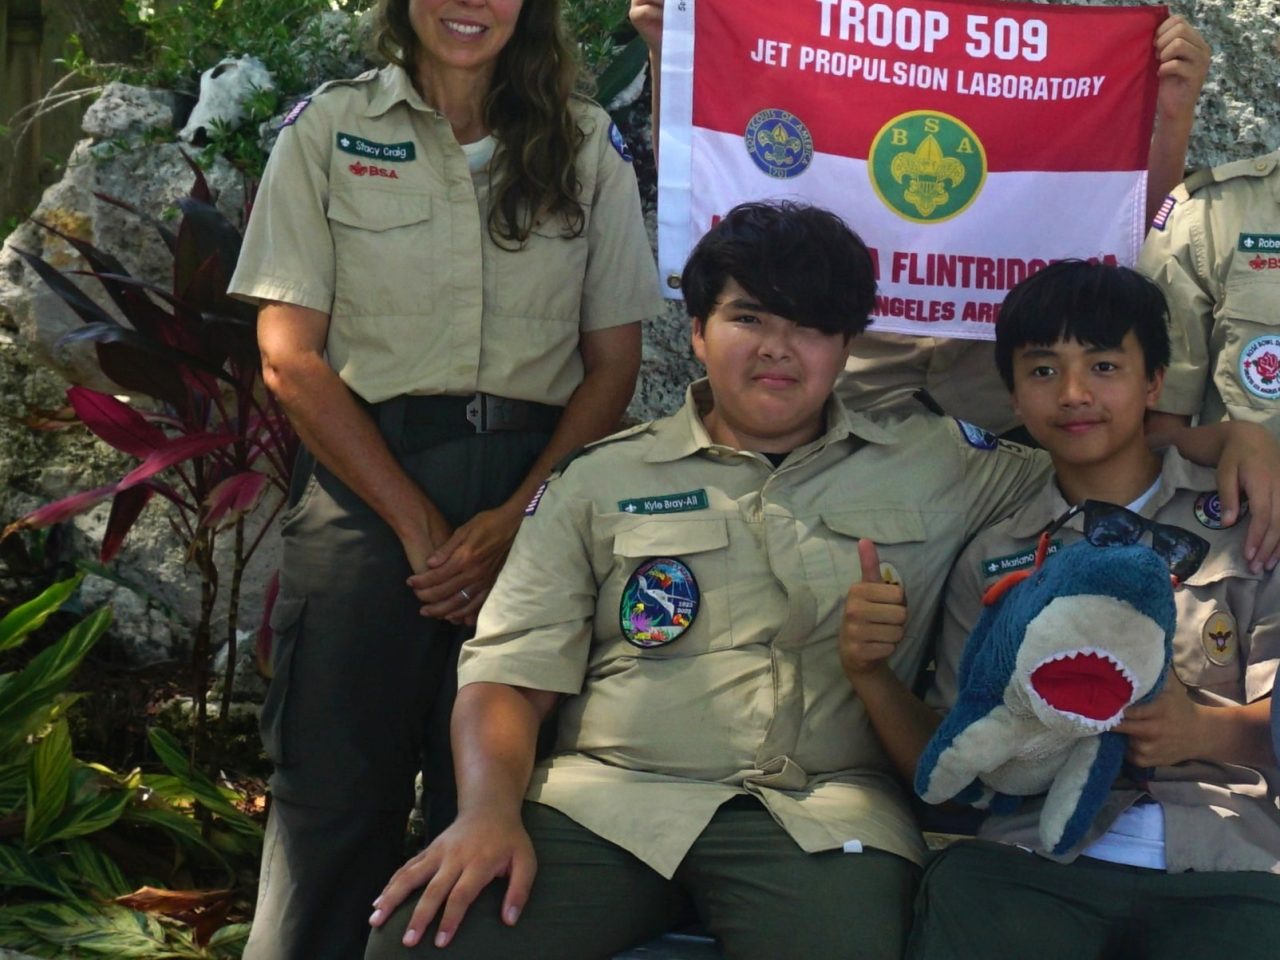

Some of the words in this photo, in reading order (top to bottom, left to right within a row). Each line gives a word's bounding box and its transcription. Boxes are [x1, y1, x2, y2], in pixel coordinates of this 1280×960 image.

[965, 14, 1048, 62] 509
[750, 38, 792, 68] JET
[799, 46, 948, 92] PROPULSION
[956, 70, 1106, 101] LABORATORY
[749, 110, 776, 129] SCOUTS
[781, 111, 793, 121] OF
[355, 140, 380, 157] Stacy
[383, 146, 407, 159] Craig
[369, 165, 399, 179] BSA
[871, 295, 956, 322] NGELES
[644, 500, 663, 512] Kyle
[1000, 552, 1035, 569] Mariano
